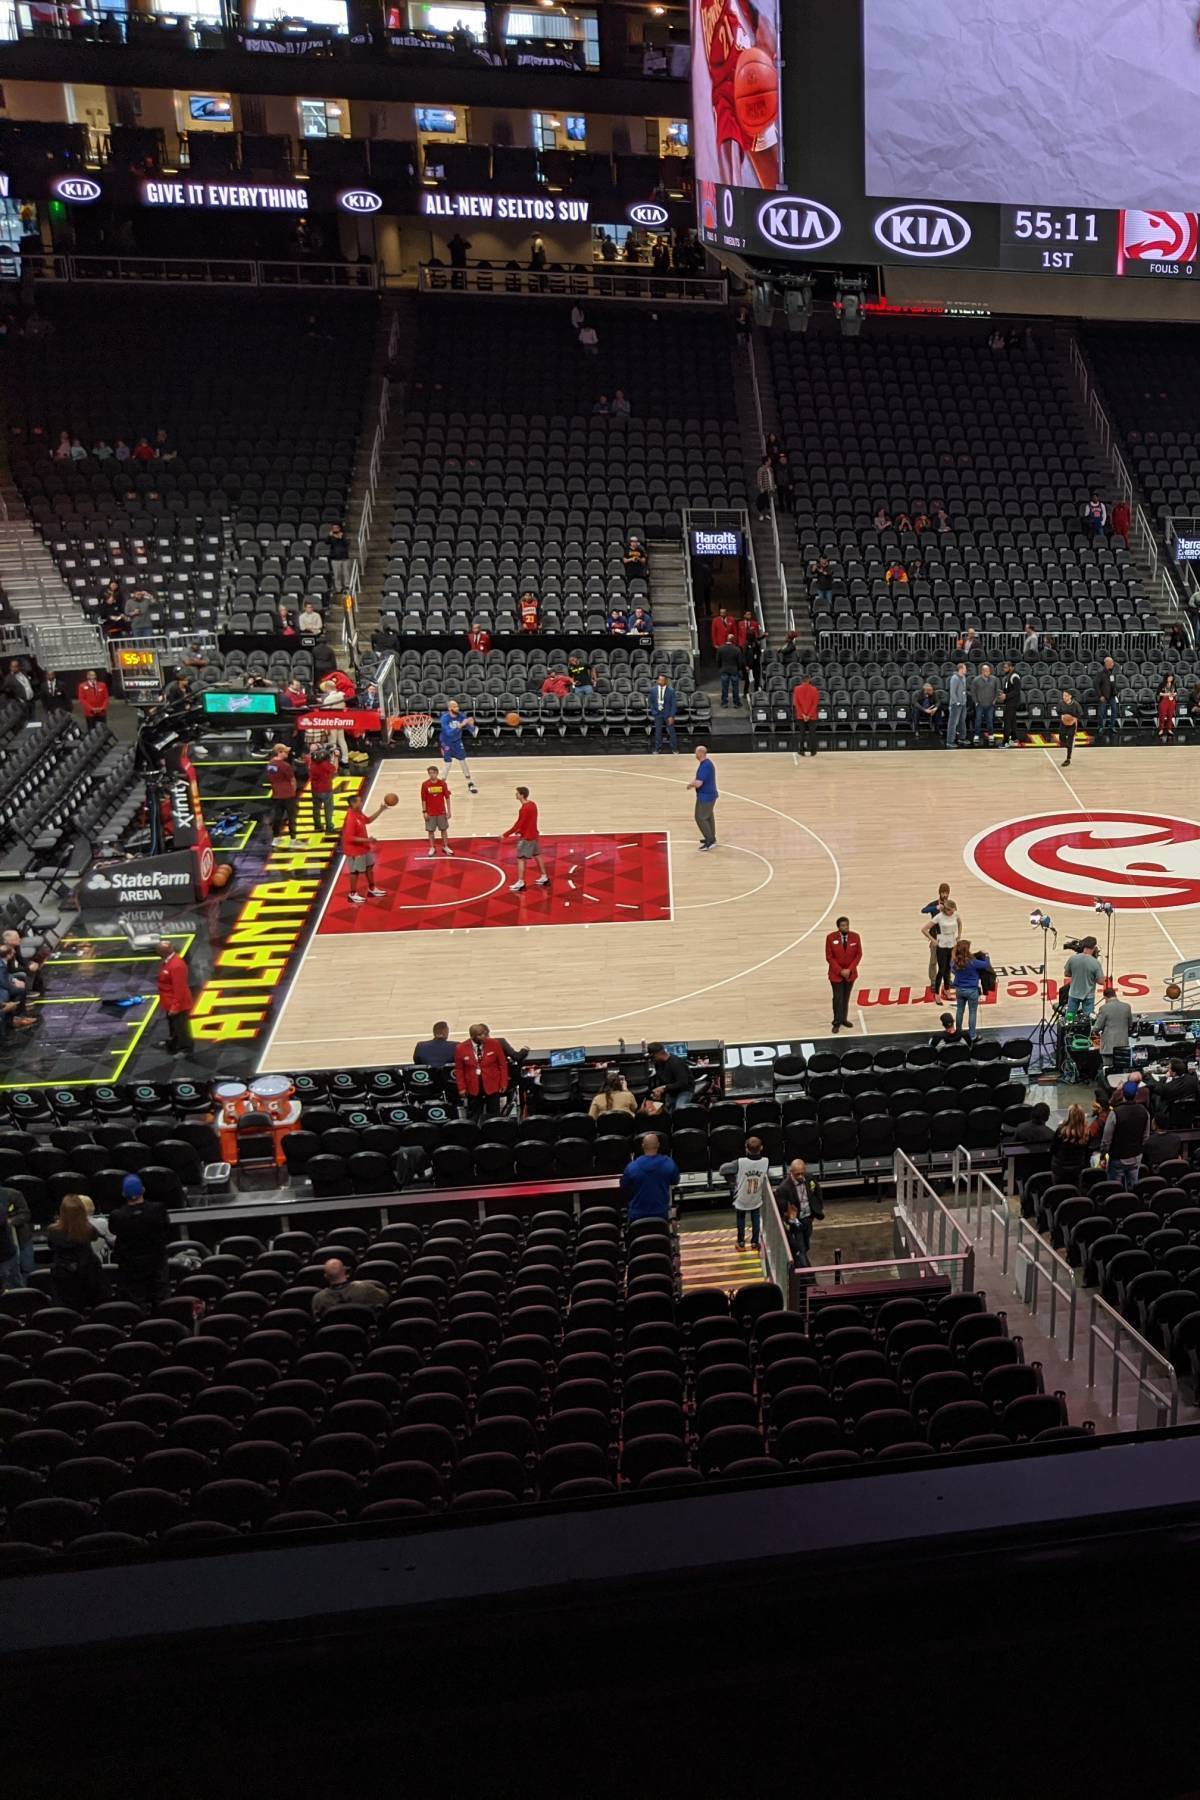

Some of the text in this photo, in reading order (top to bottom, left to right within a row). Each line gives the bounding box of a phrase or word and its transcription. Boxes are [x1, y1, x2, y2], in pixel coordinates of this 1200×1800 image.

[147, 183, 308, 209] GIVE IT EVERYTHING
[426, 195, 589, 221] ALL-NEW SELTOS SUV
[723, 189, 734, 228] 0
[1015, 210, 1099, 242] 55:11
[1043, 252, 1074, 268] 1ST
[1150, 263, 1193, 275] FOULS 0
[124, 653, 153, 665] 55:11
[311, 716, 354, 728] StateFarm
[171, 779, 194, 829] xfinity
[112, 871, 190, 889] StateFarm
[120, 889, 163, 902] ARENA
[189, 878, 322, 1041] ATLANTA
